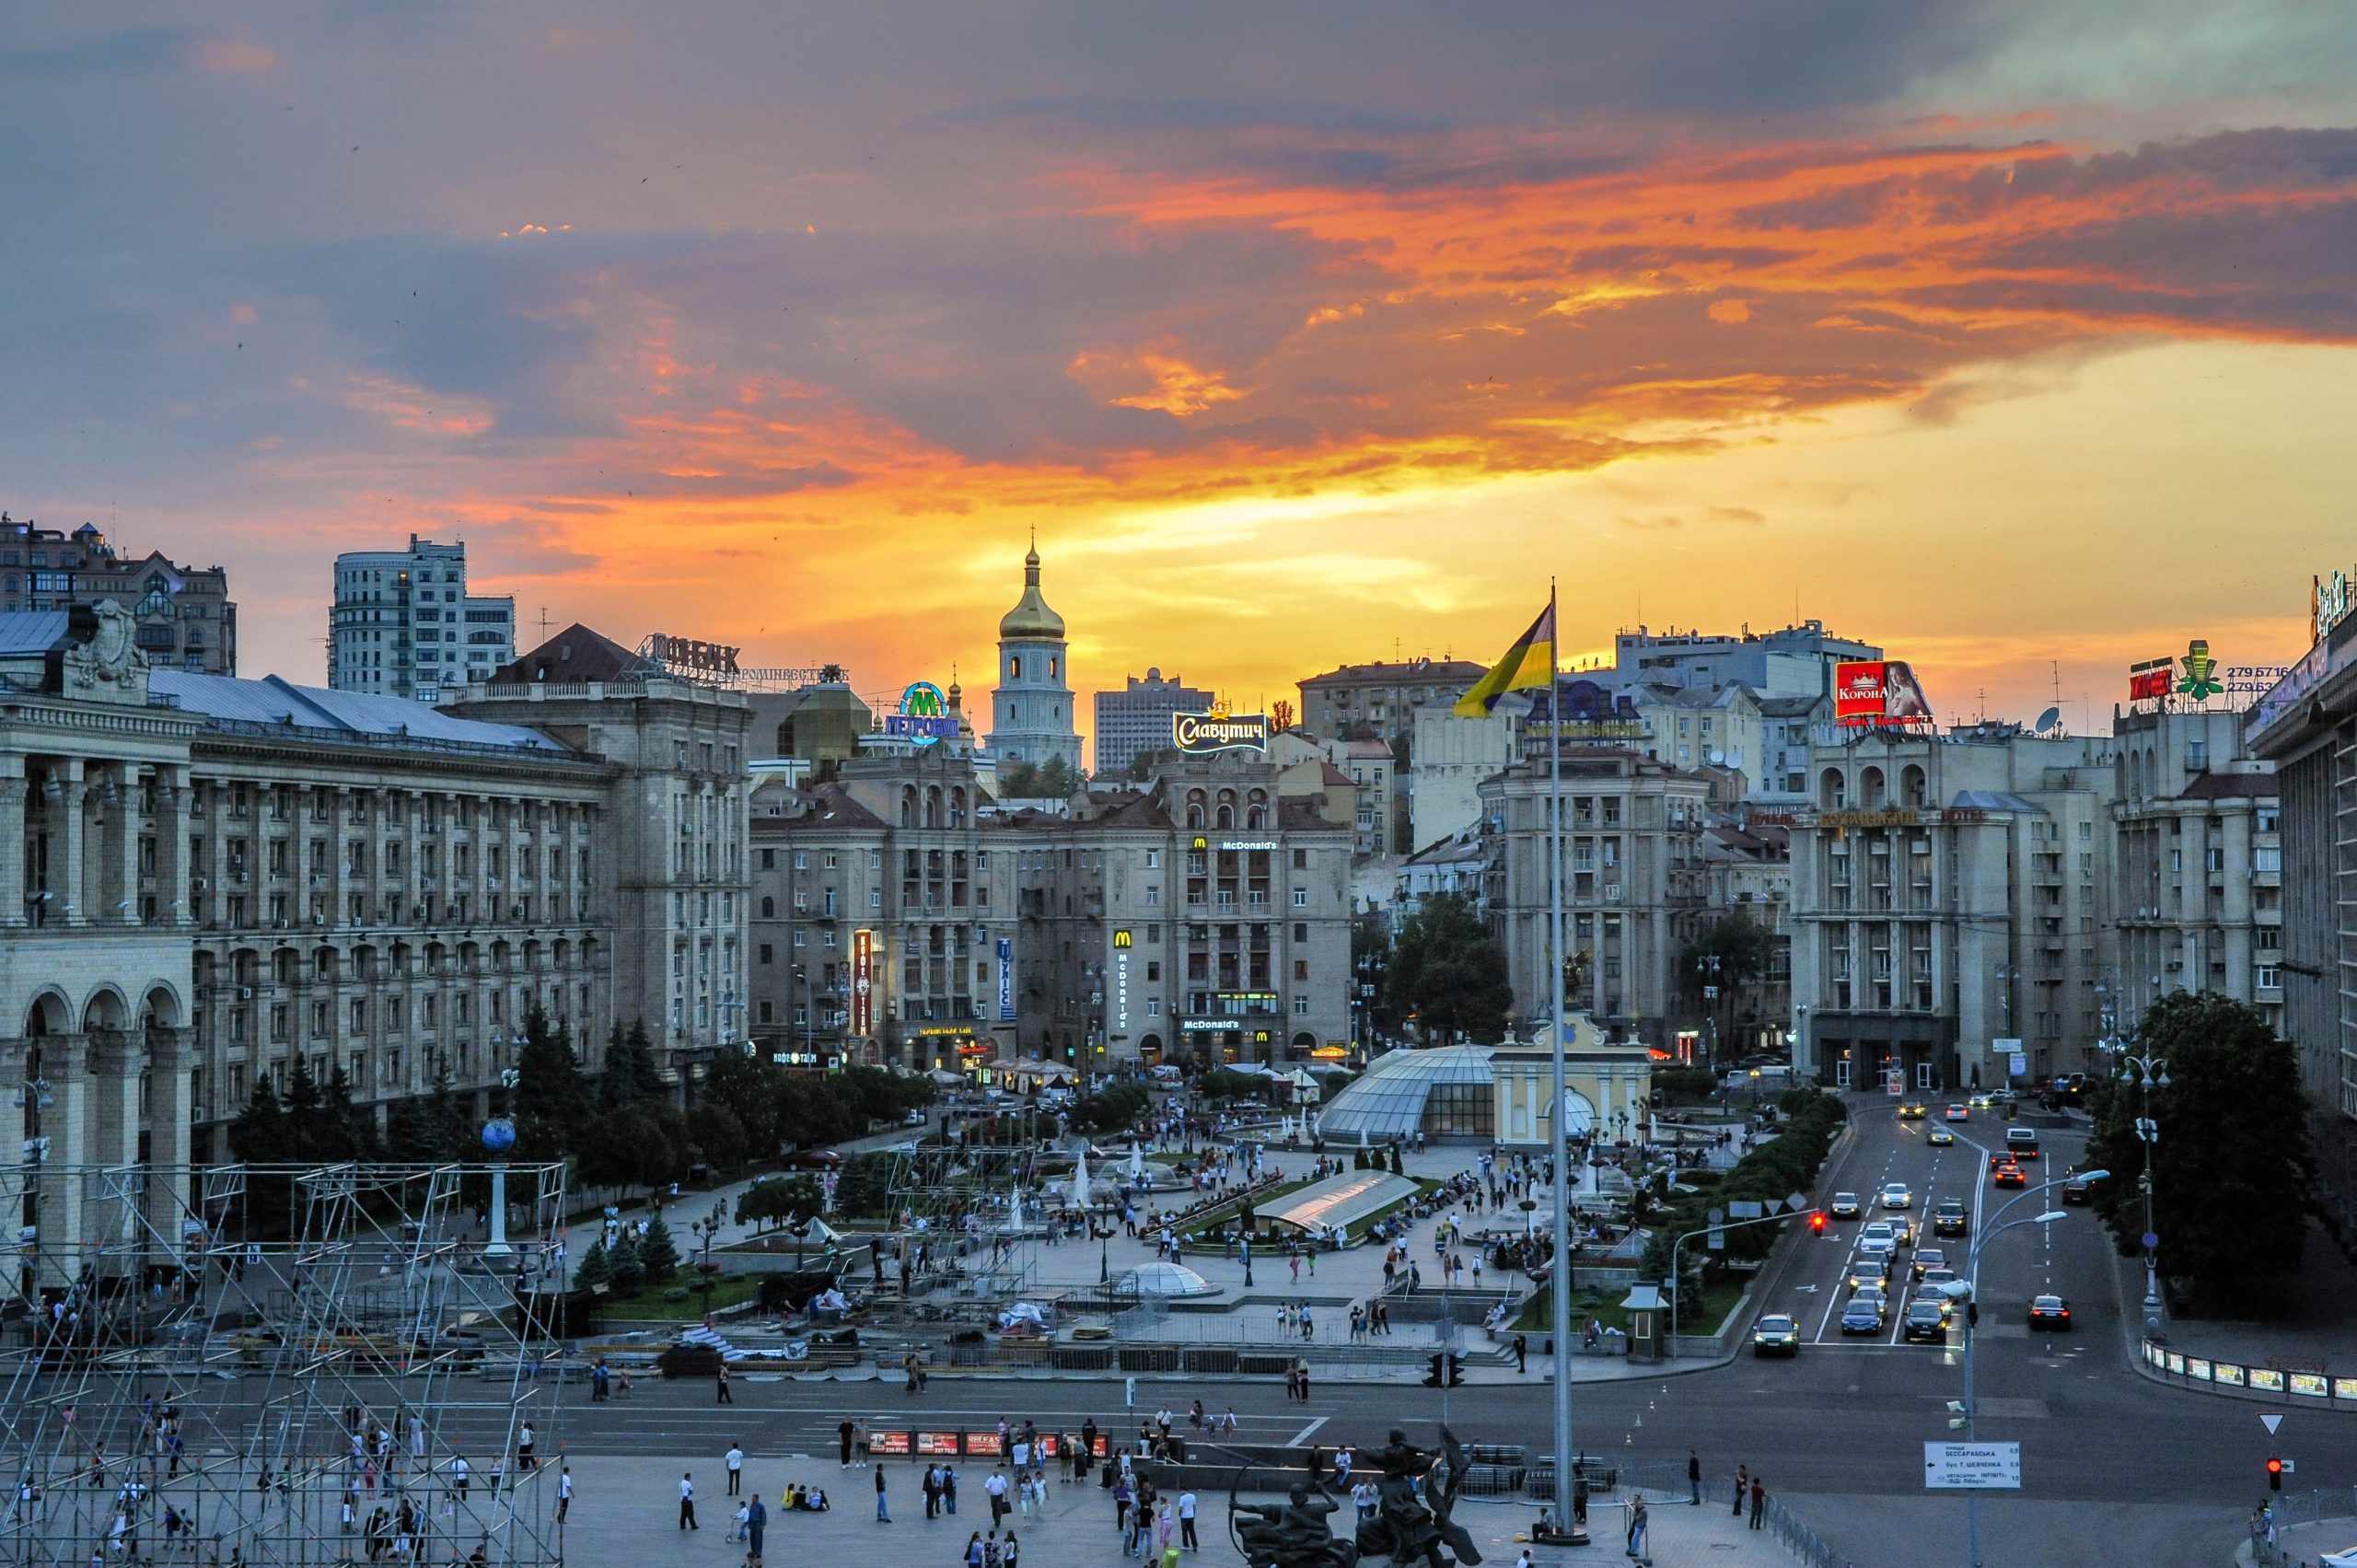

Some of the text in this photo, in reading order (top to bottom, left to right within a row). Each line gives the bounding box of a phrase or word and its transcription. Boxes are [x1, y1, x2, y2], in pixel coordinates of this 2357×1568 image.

[886, 714, 959, 738] МЕТРОБУД
[1178, 716, 1264, 745] Славутич
[1222, 842, 1277, 850] McDonald's
[1119, 954, 1128, 1028] McDonald's
[1184, 1020, 1239, 1029] McDonald's
